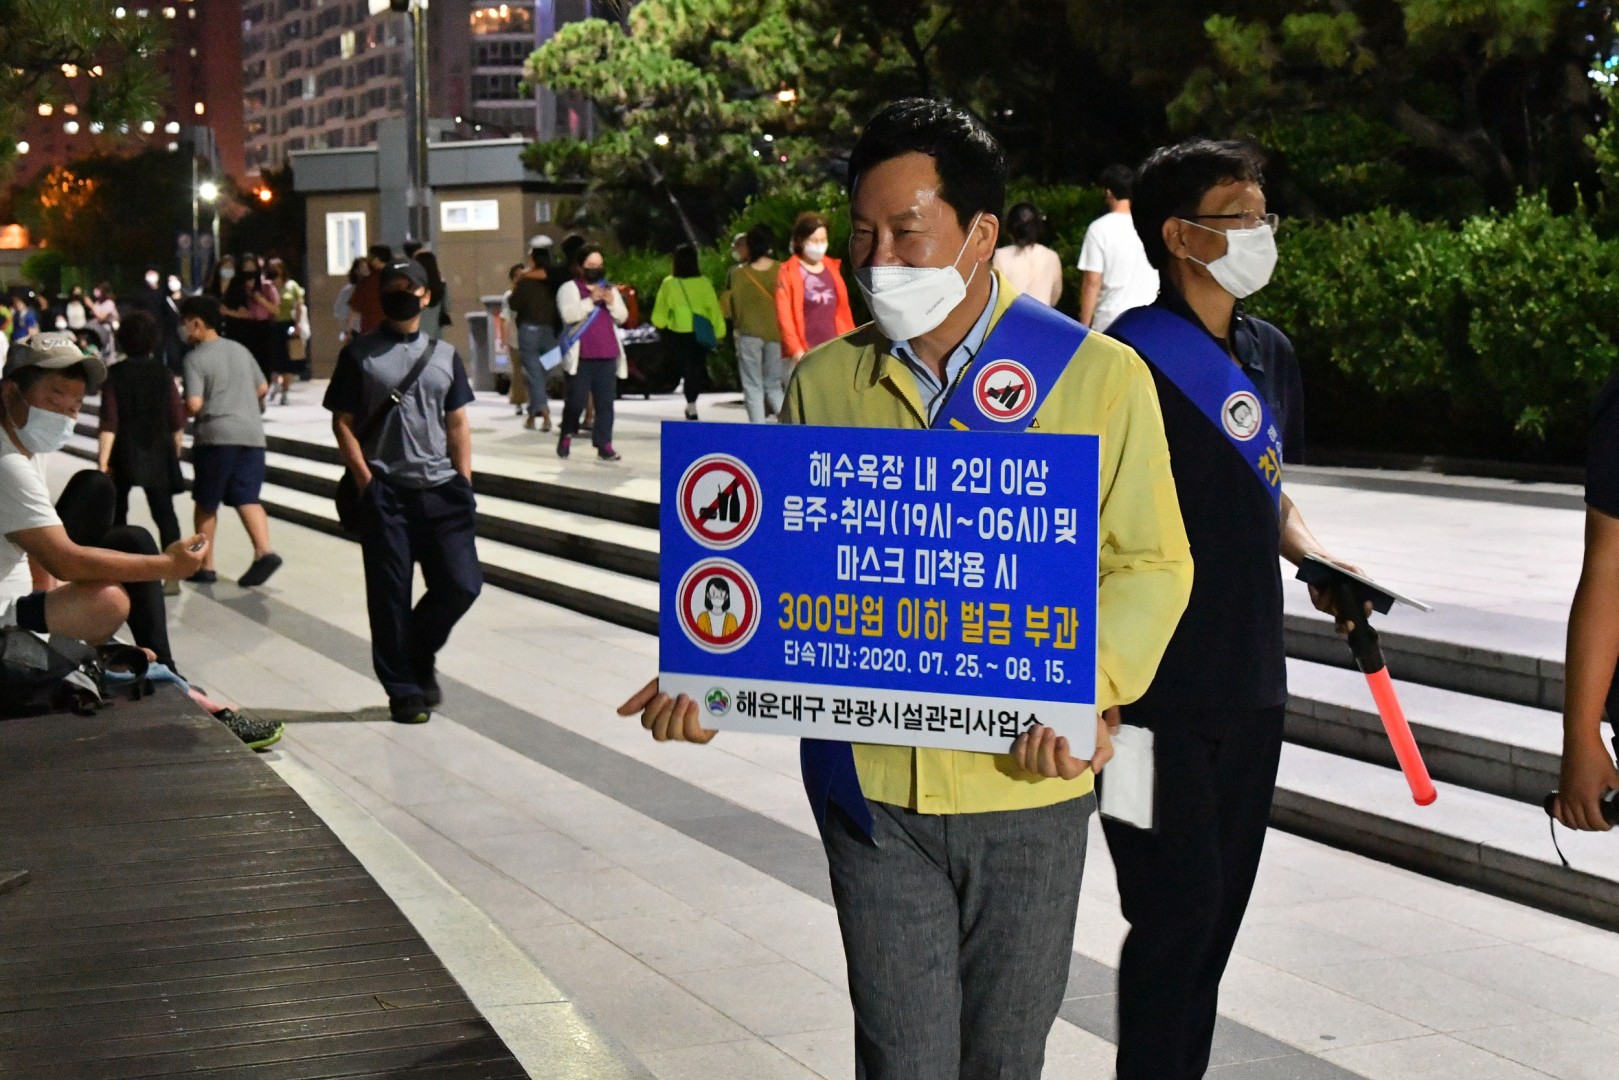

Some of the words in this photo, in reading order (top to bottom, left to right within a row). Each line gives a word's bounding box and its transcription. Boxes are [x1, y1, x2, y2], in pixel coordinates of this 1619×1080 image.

[809, 450, 905, 491] 해수욕장
[914, 456, 938, 492] 내
[951, 457, 992, 494] 2인
[1000, 458, 1049, 496] 이상
[1054, 507, 1078, 544] 및
[836, 544, 906, 584] 마스크
[914, 548, 986, 589] 미착용
[994, 553, 1018, 590] 시
[778, 592, 884, 638] 300만원
[897, 597, 949, 641] 이하
[960, 600, 1012, 646] 벌금
[1024, 603, 1079, 650] 부과
[918, 650, 949, 677] 07.
[1005, 656, 1036, 683] 08.
[1044, 659, 1072, 685] 15.
[736, 690, 826, 723] 해운대구
